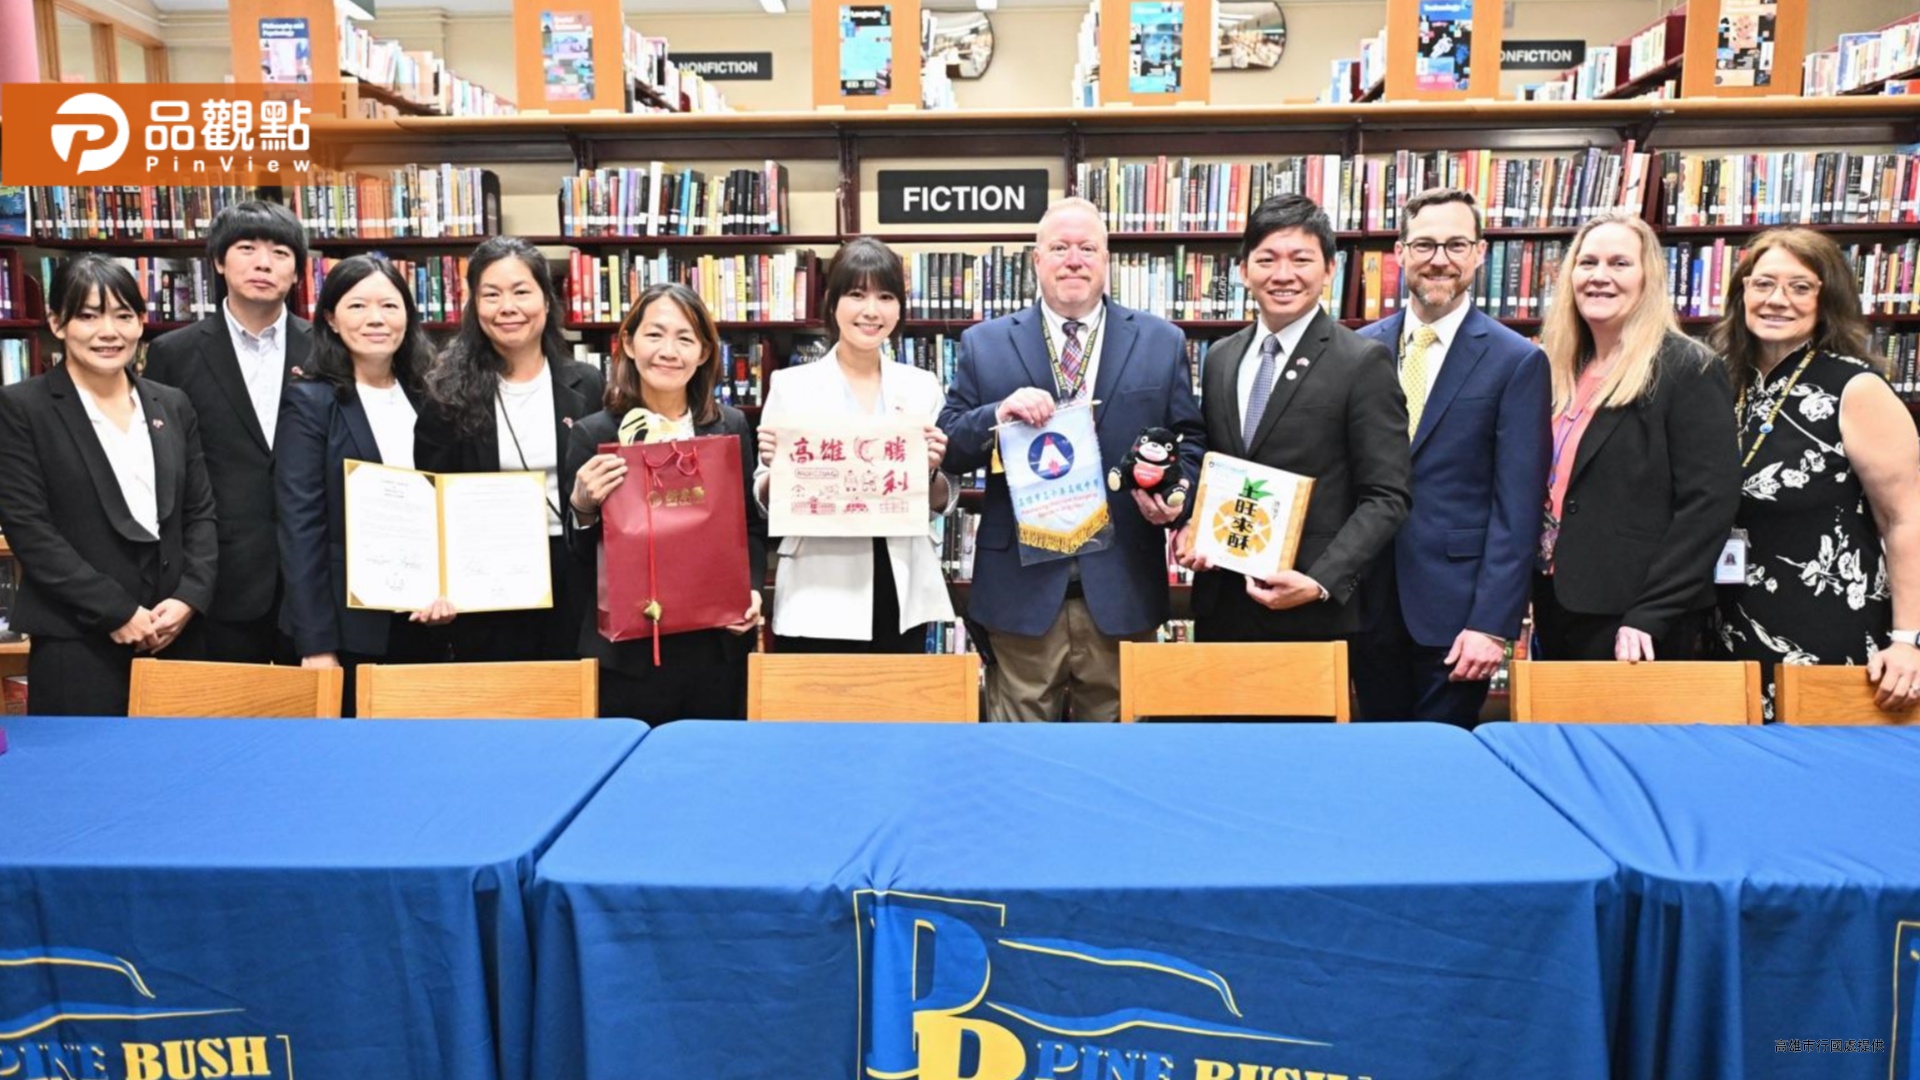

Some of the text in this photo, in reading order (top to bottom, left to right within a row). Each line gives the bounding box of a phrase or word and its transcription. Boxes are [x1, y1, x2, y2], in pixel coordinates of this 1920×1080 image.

[678, 61, 758, 74] NONFICTION
[902, 185, 1026, 213] FICTION
[790, 436, 847, 465] 高雄
[1227, 483, 1260, 550] 土旺來酥
[121, 1036, 271, 1080] BUSH
[1036, 1040, 1175, 1080] PINE
